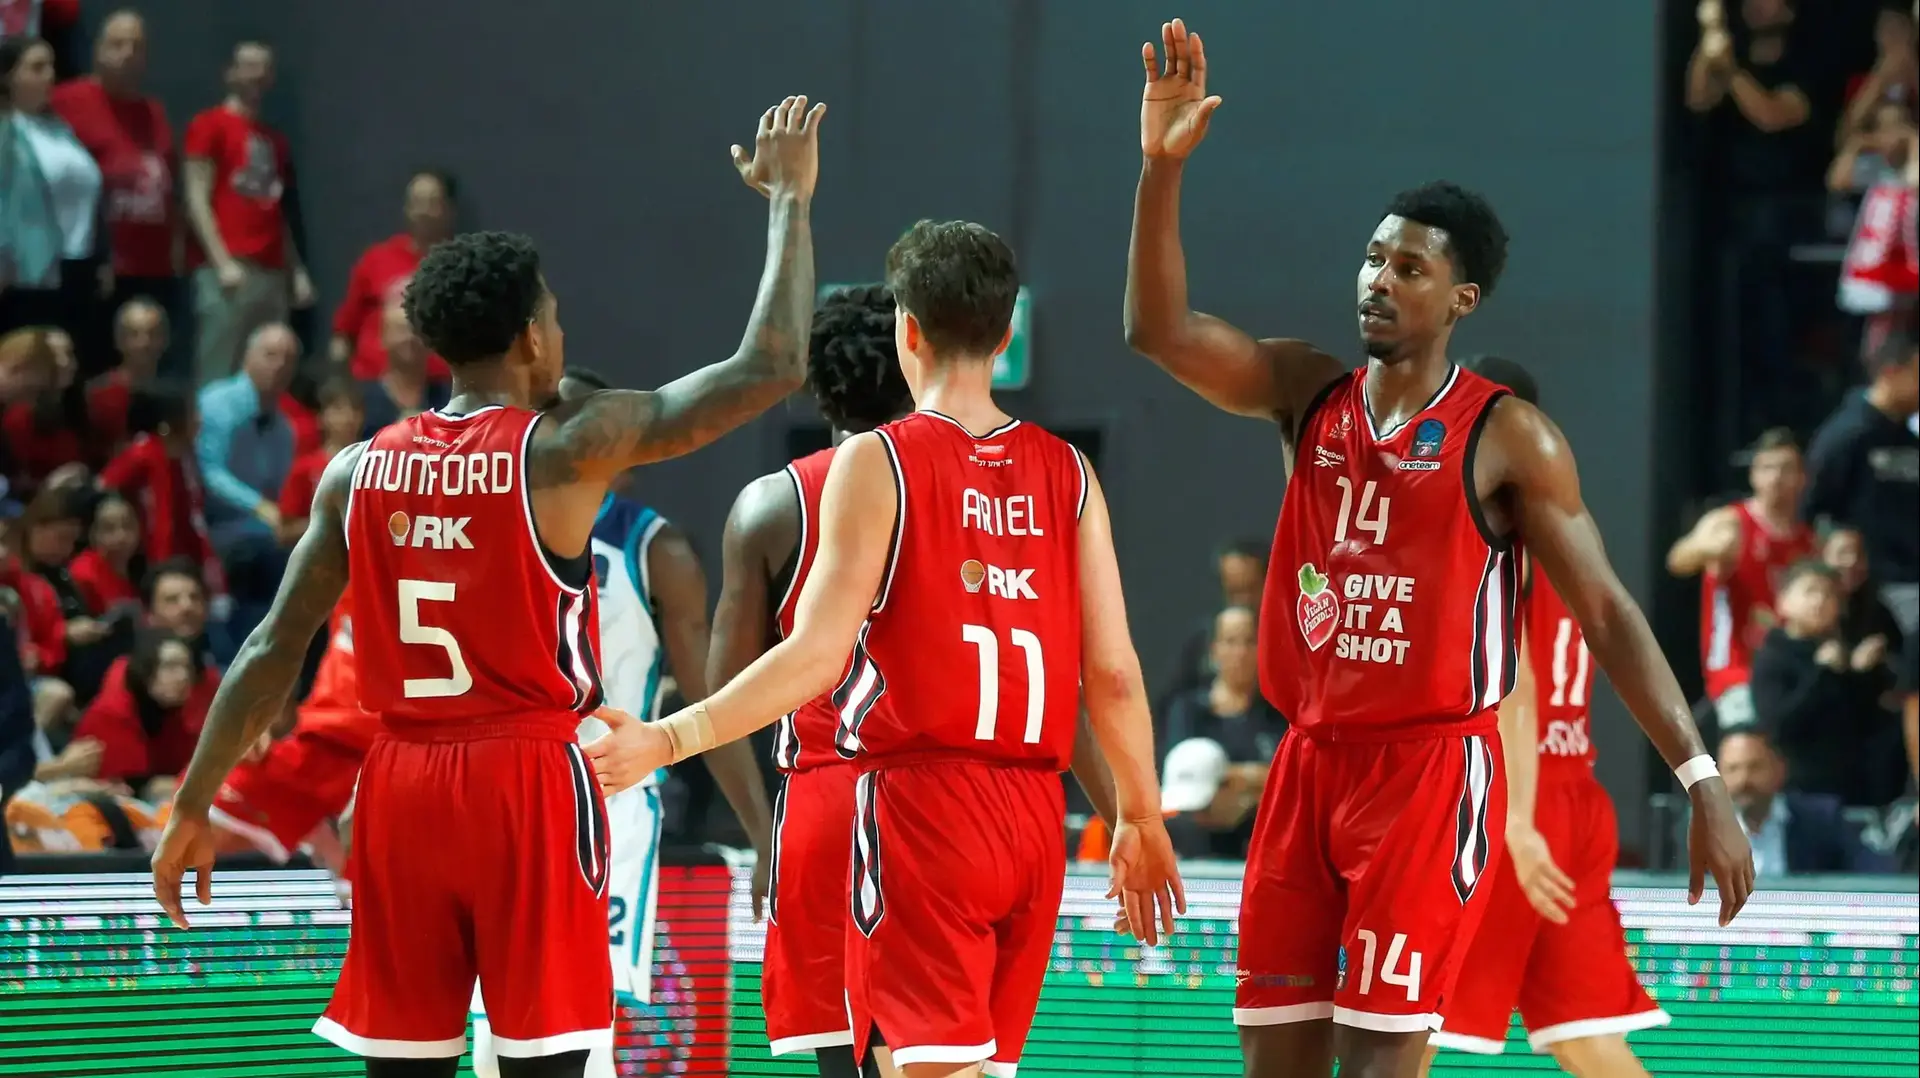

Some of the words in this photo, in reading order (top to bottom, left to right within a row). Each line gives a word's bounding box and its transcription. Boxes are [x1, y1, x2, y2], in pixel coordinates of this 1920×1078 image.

[1315, 445, 1345, 461] Reebok
[1399, 461, 1440, 469] oneteam
[355, 450, 513, 496] MUNFORD
[962, 488, 1043, 536] ARIEL
[1334, 476, 1391, 545] 14
[1344, 574, 1415, 603] GIVE
[1304, 597, 1329, 620] VEGAN
[1304, 606, 1334, 635] FRIENDLY
[1344, 603, 1373, 629] IT
[1379, 607, 1404, 633] A
[398, 579, 473, 698] 5
[1336, 633, 1410, 665] SHOT
[962, 623, 1046, 744] 11
[1358, 928, 1422, 1002] 14
